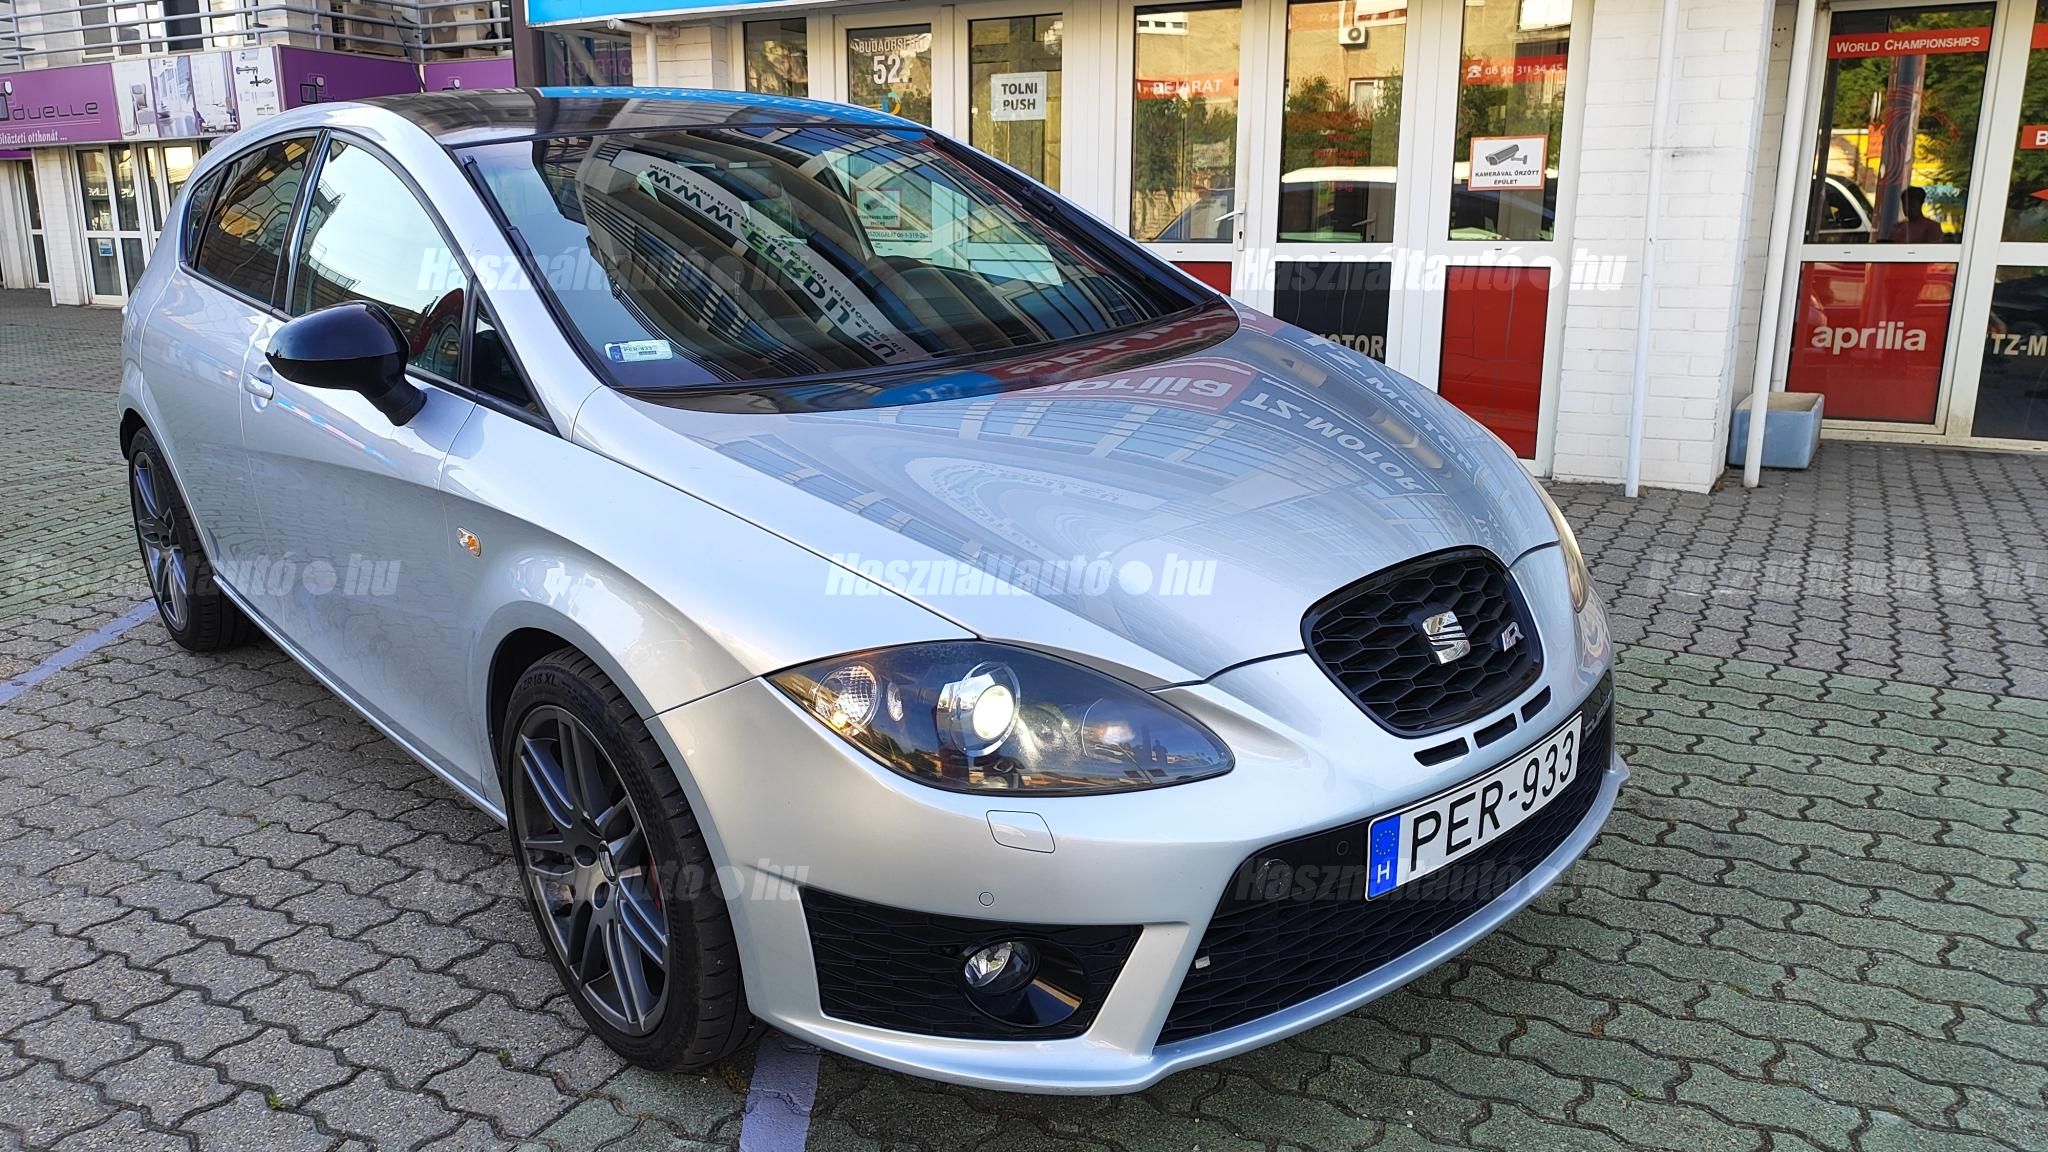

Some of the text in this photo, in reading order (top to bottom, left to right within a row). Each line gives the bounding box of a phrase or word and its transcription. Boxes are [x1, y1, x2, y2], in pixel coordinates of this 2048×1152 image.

[1836, 36, 1980, 53] WORLD CHAMPIONSHIPS
[1517, 65, 1531, 76] 311
[1001, 82, 1038, 95] TOLNI
[1003, 98, 1036, 111] PUSH
[1320, 333, 1384, 359] TOR
[1811, 320, 1927, 356] aprilia
[1409, 729, 1575, 874] PER-933
[1376, 860, 1391, 885] H
